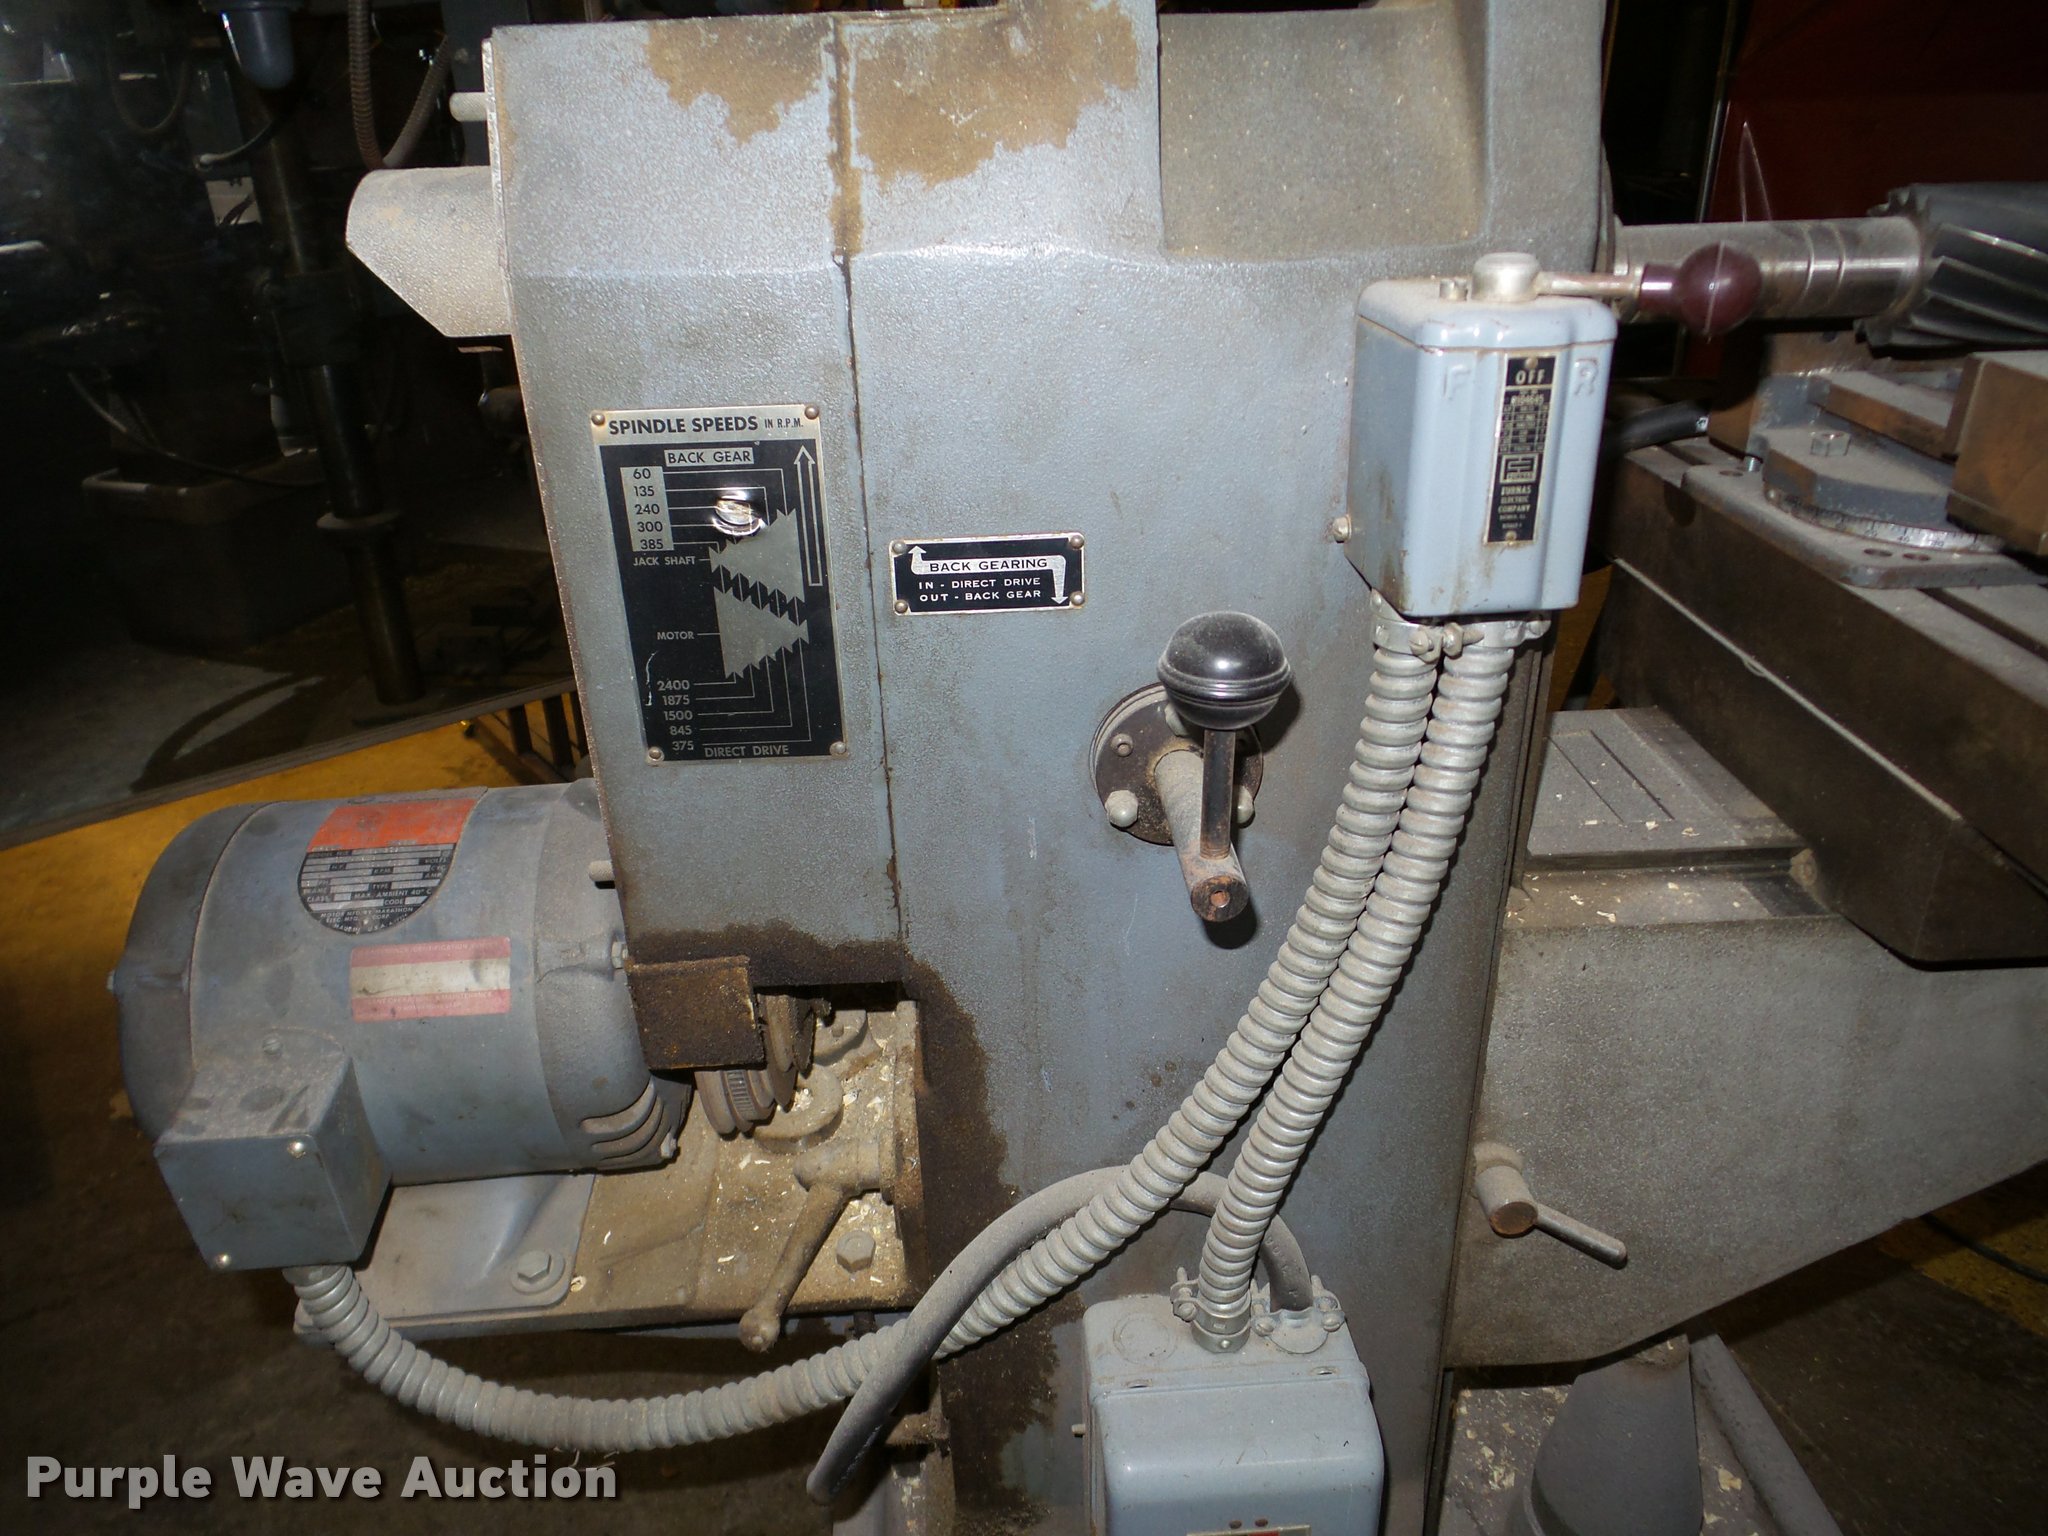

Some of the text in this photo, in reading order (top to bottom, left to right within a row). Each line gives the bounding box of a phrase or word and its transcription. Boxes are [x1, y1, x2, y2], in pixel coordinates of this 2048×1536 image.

[1515, 369, 1546, 385] OFF
[609, 415, 804, 435] SPINDLE SPEEDS IN R.P.M.
[667, 450, 751, 464] BACK GEAR
[633, 468, 652, 480] 60
[634, 486, 655, 497] 135
[636, 504, 660, 515] 240
[1498, 504, 1531, 514] COMPANY
[637, 521, 663, 533] 300
[640, 539, 664, 550] 385
[633, 556, 696, 567] JACK SHAFT
[929, 558, 1048, 572] BACK GEARING
[918, 581, 934, 590] IN
[951, 579, 996, 589] DIRECT
[1003, 577, 1041, 587] DRIVE
[919, 593, 949, 602] OUT
[965, 591, 1000, 601] BACK
[1006, 589, 1041, 599] GEAR
[656, 631, 695, 641] MOTOR
[656, 680, 690, 691] 2400
[662, 695, 690, 706] 1875
[663, 710, 693, 721] 1500
[669, 725, 692, 736] 845
[672, 741, 694, 751] 375
[705, 744, 789, 758] DIRECT DRIVE
[376, 889, 409, 898] AMBIENT
